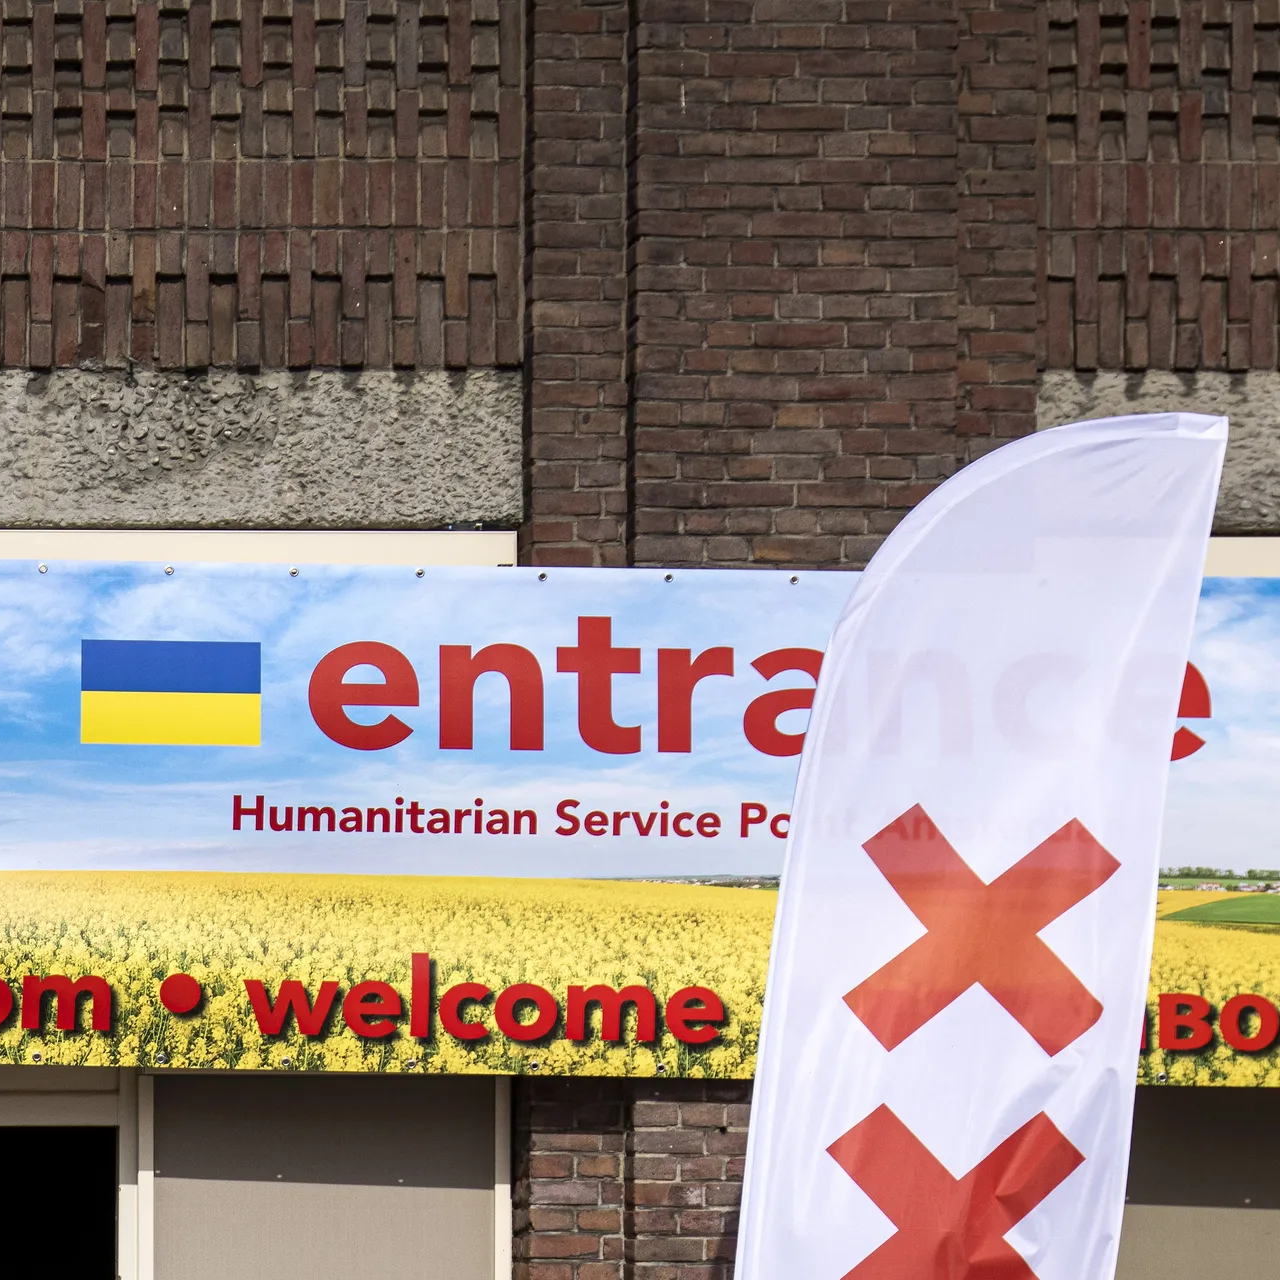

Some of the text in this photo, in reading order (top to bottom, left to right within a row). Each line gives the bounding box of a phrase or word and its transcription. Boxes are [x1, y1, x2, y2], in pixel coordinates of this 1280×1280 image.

[232, 795, 538, 837] Humanitarian
[556, 799, 723, 840] Service
[244, 953, 724, 1045] welcome
